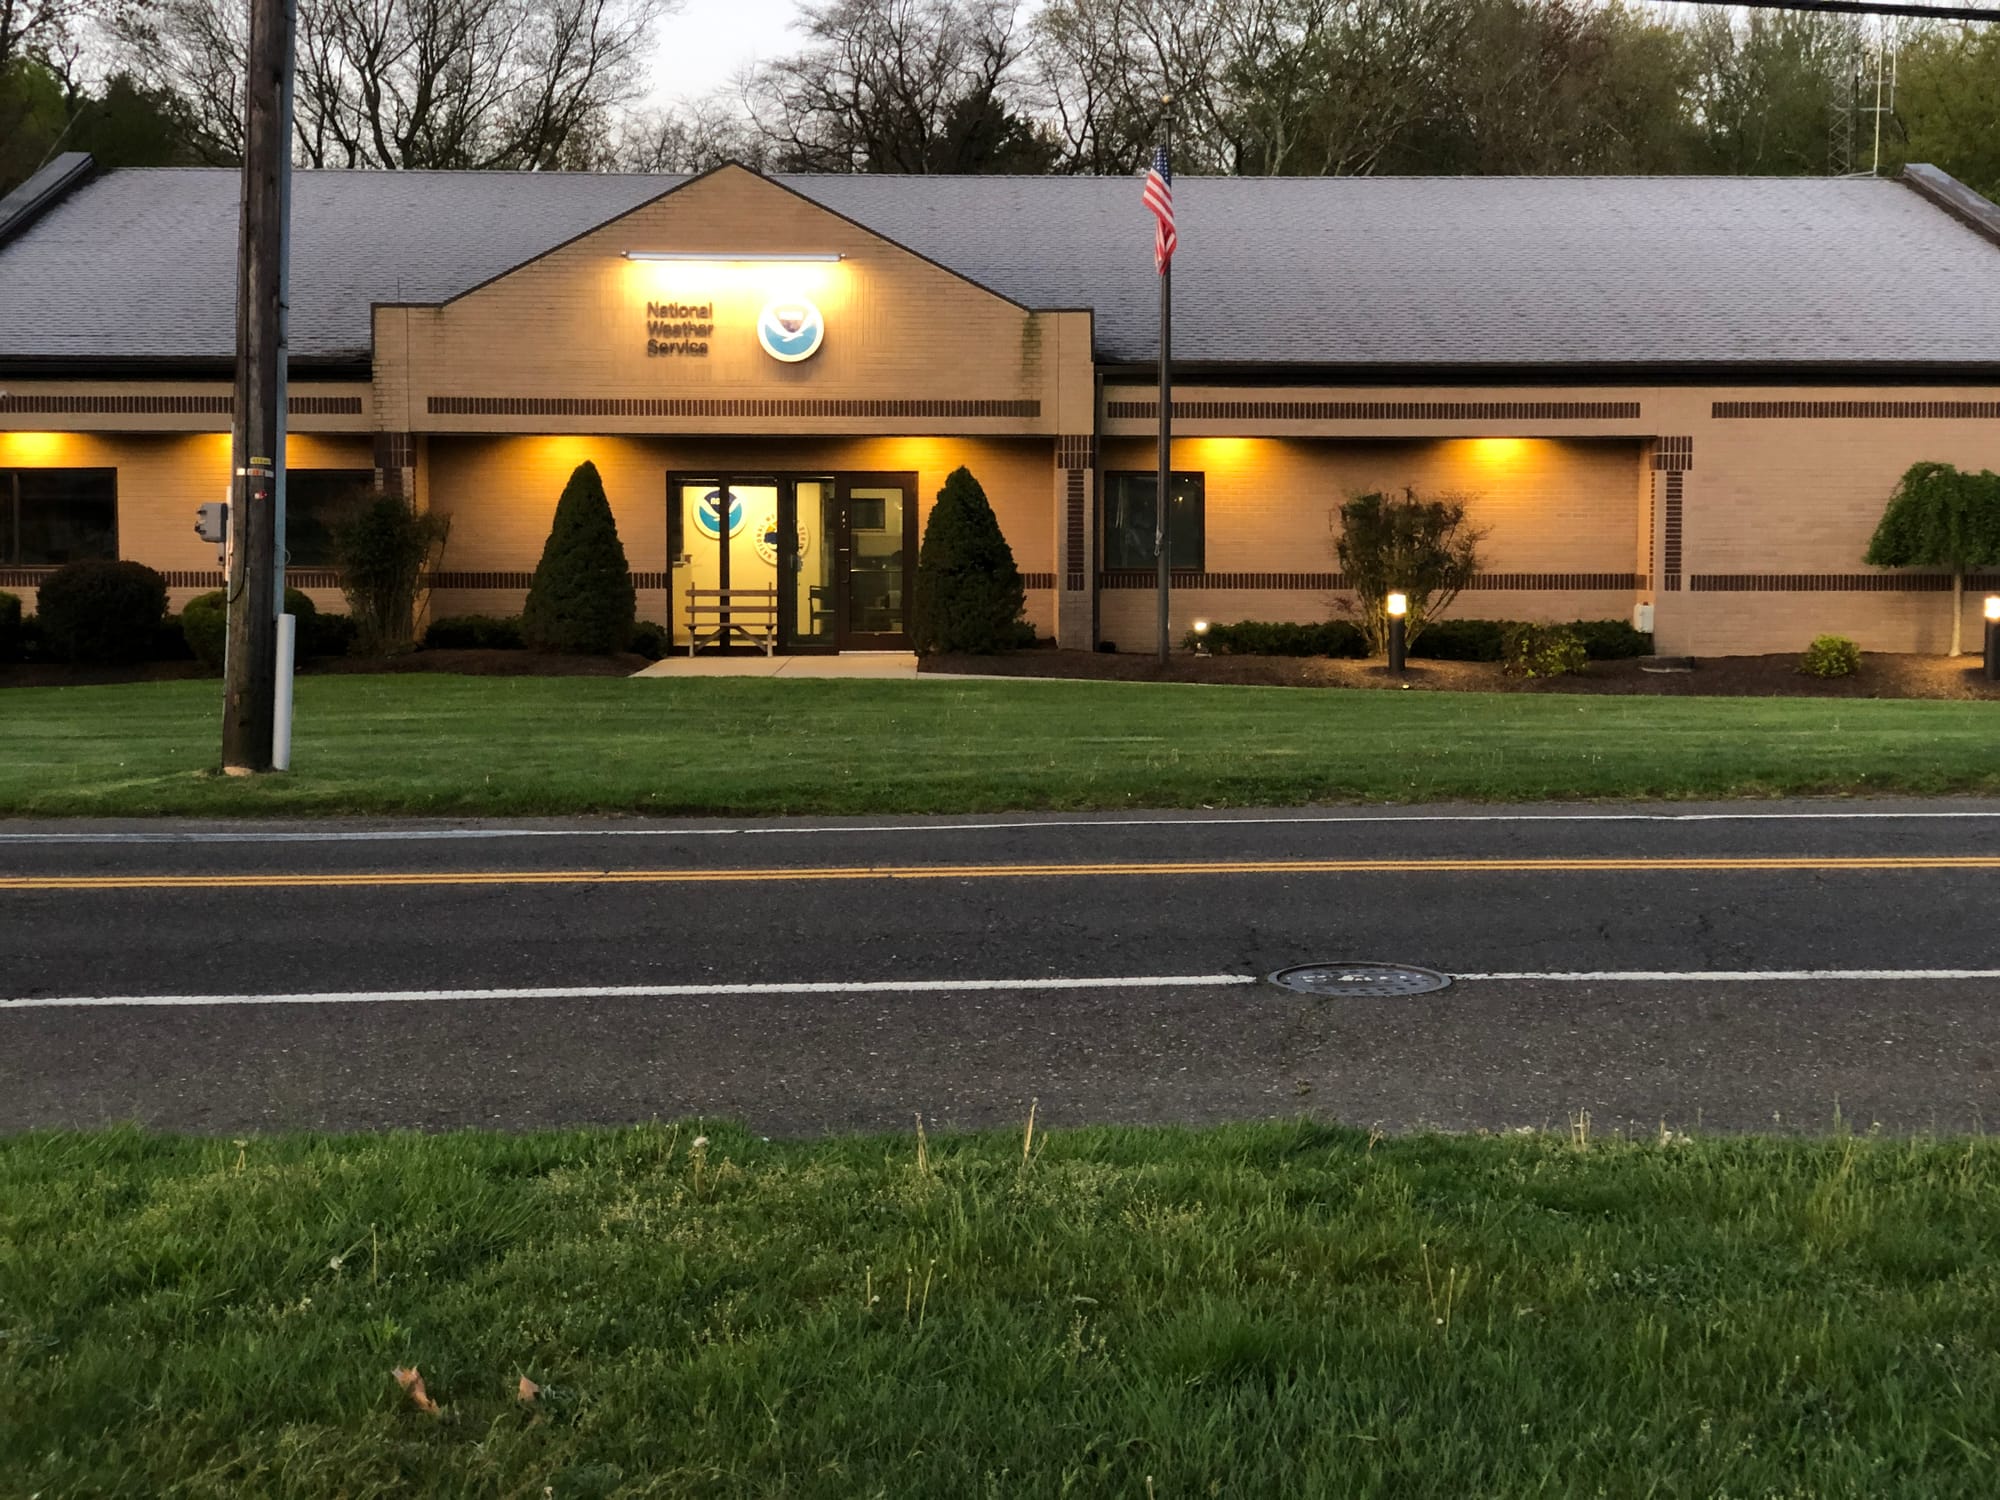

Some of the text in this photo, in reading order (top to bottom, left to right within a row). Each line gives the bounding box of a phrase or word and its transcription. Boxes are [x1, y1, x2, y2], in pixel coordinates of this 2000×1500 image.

[647, 301, 713, 318] National
[647, 320, 714, 338] Weather
[647, 339, 708, 355] Service
